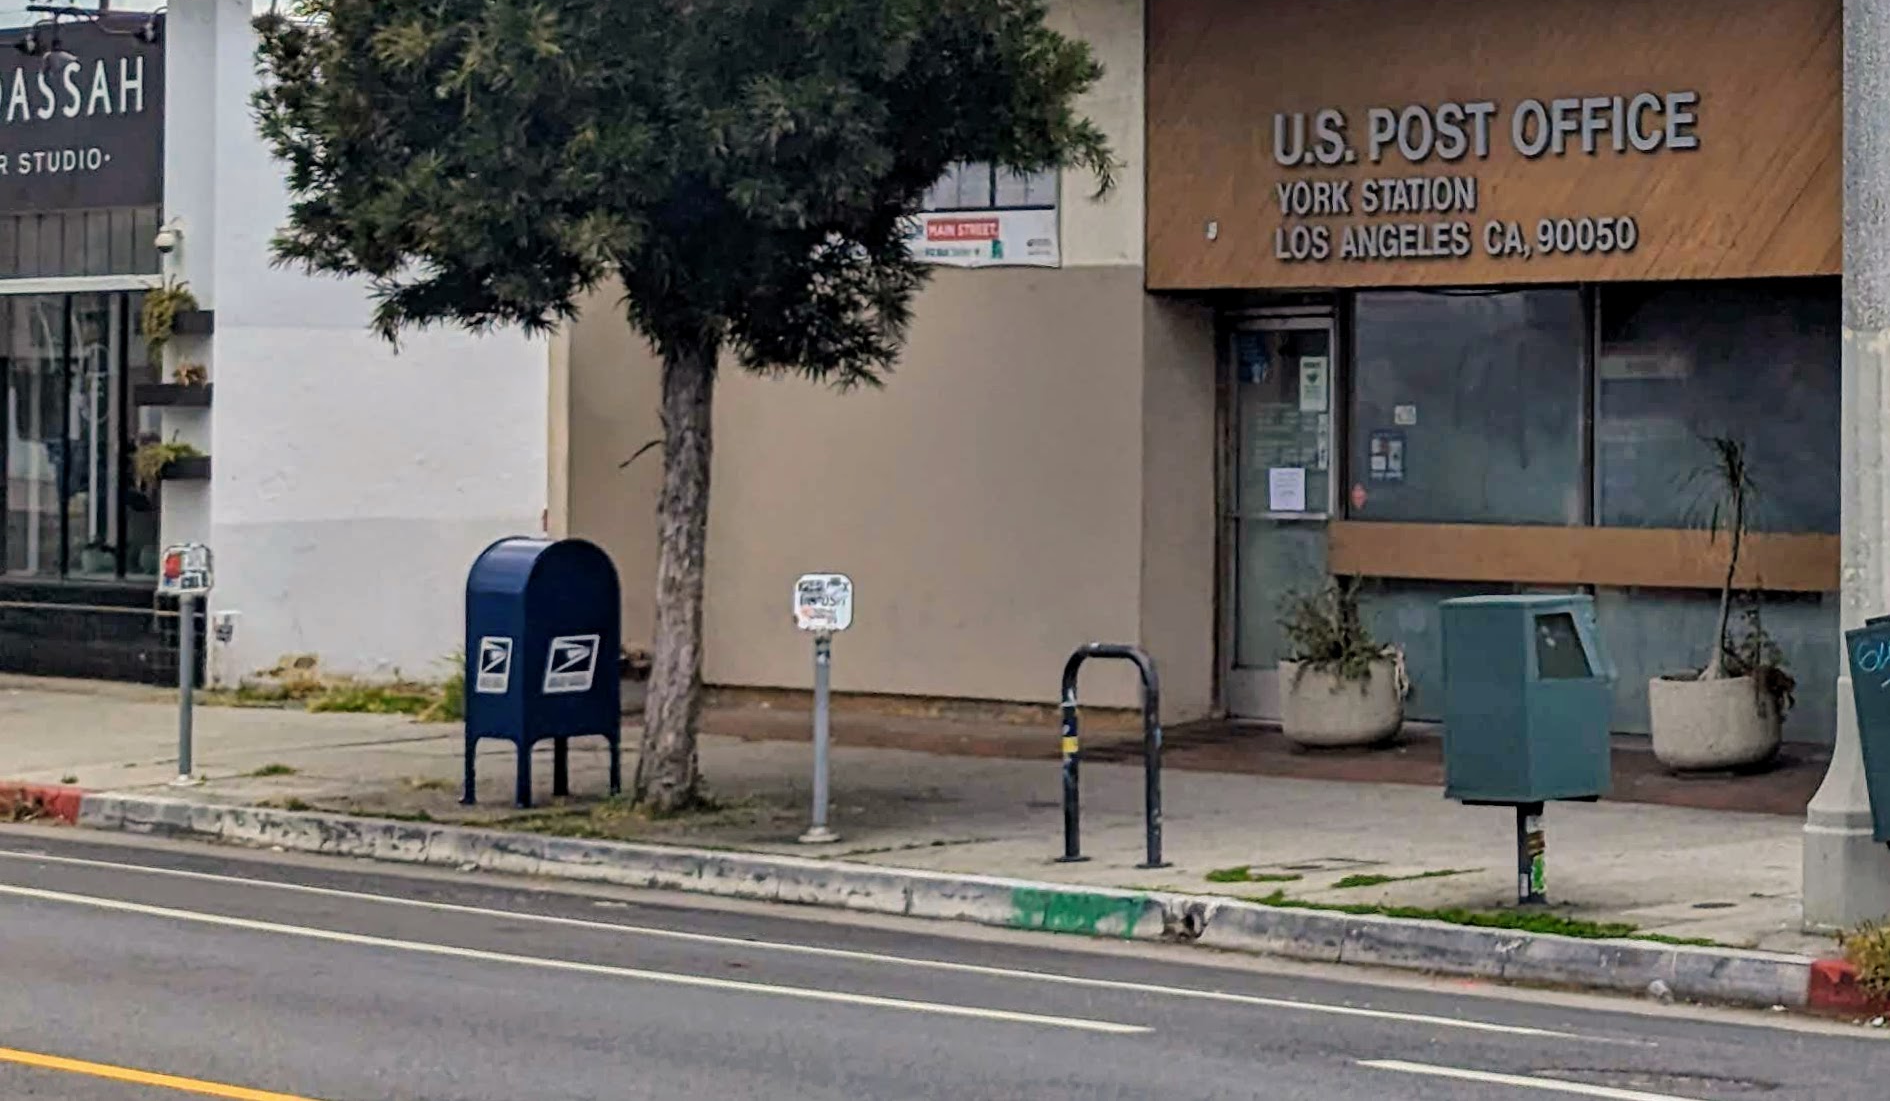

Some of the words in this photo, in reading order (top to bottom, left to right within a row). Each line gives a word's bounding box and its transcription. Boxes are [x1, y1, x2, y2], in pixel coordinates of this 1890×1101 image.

[0, 56, 144, 121] ASSAH
[1274, 108, 1355, 166] U.S.
[1368, 101, 1496, 161] POST
[1512, 92, 1698, 156] OFFICE
[1277, 181, 1350, 214] YORK
[1361, 176, 1475, 212] STATION
[1275, 225, 1330, 260] LOS
[1340, 221, 1471, 258] ANGELES
